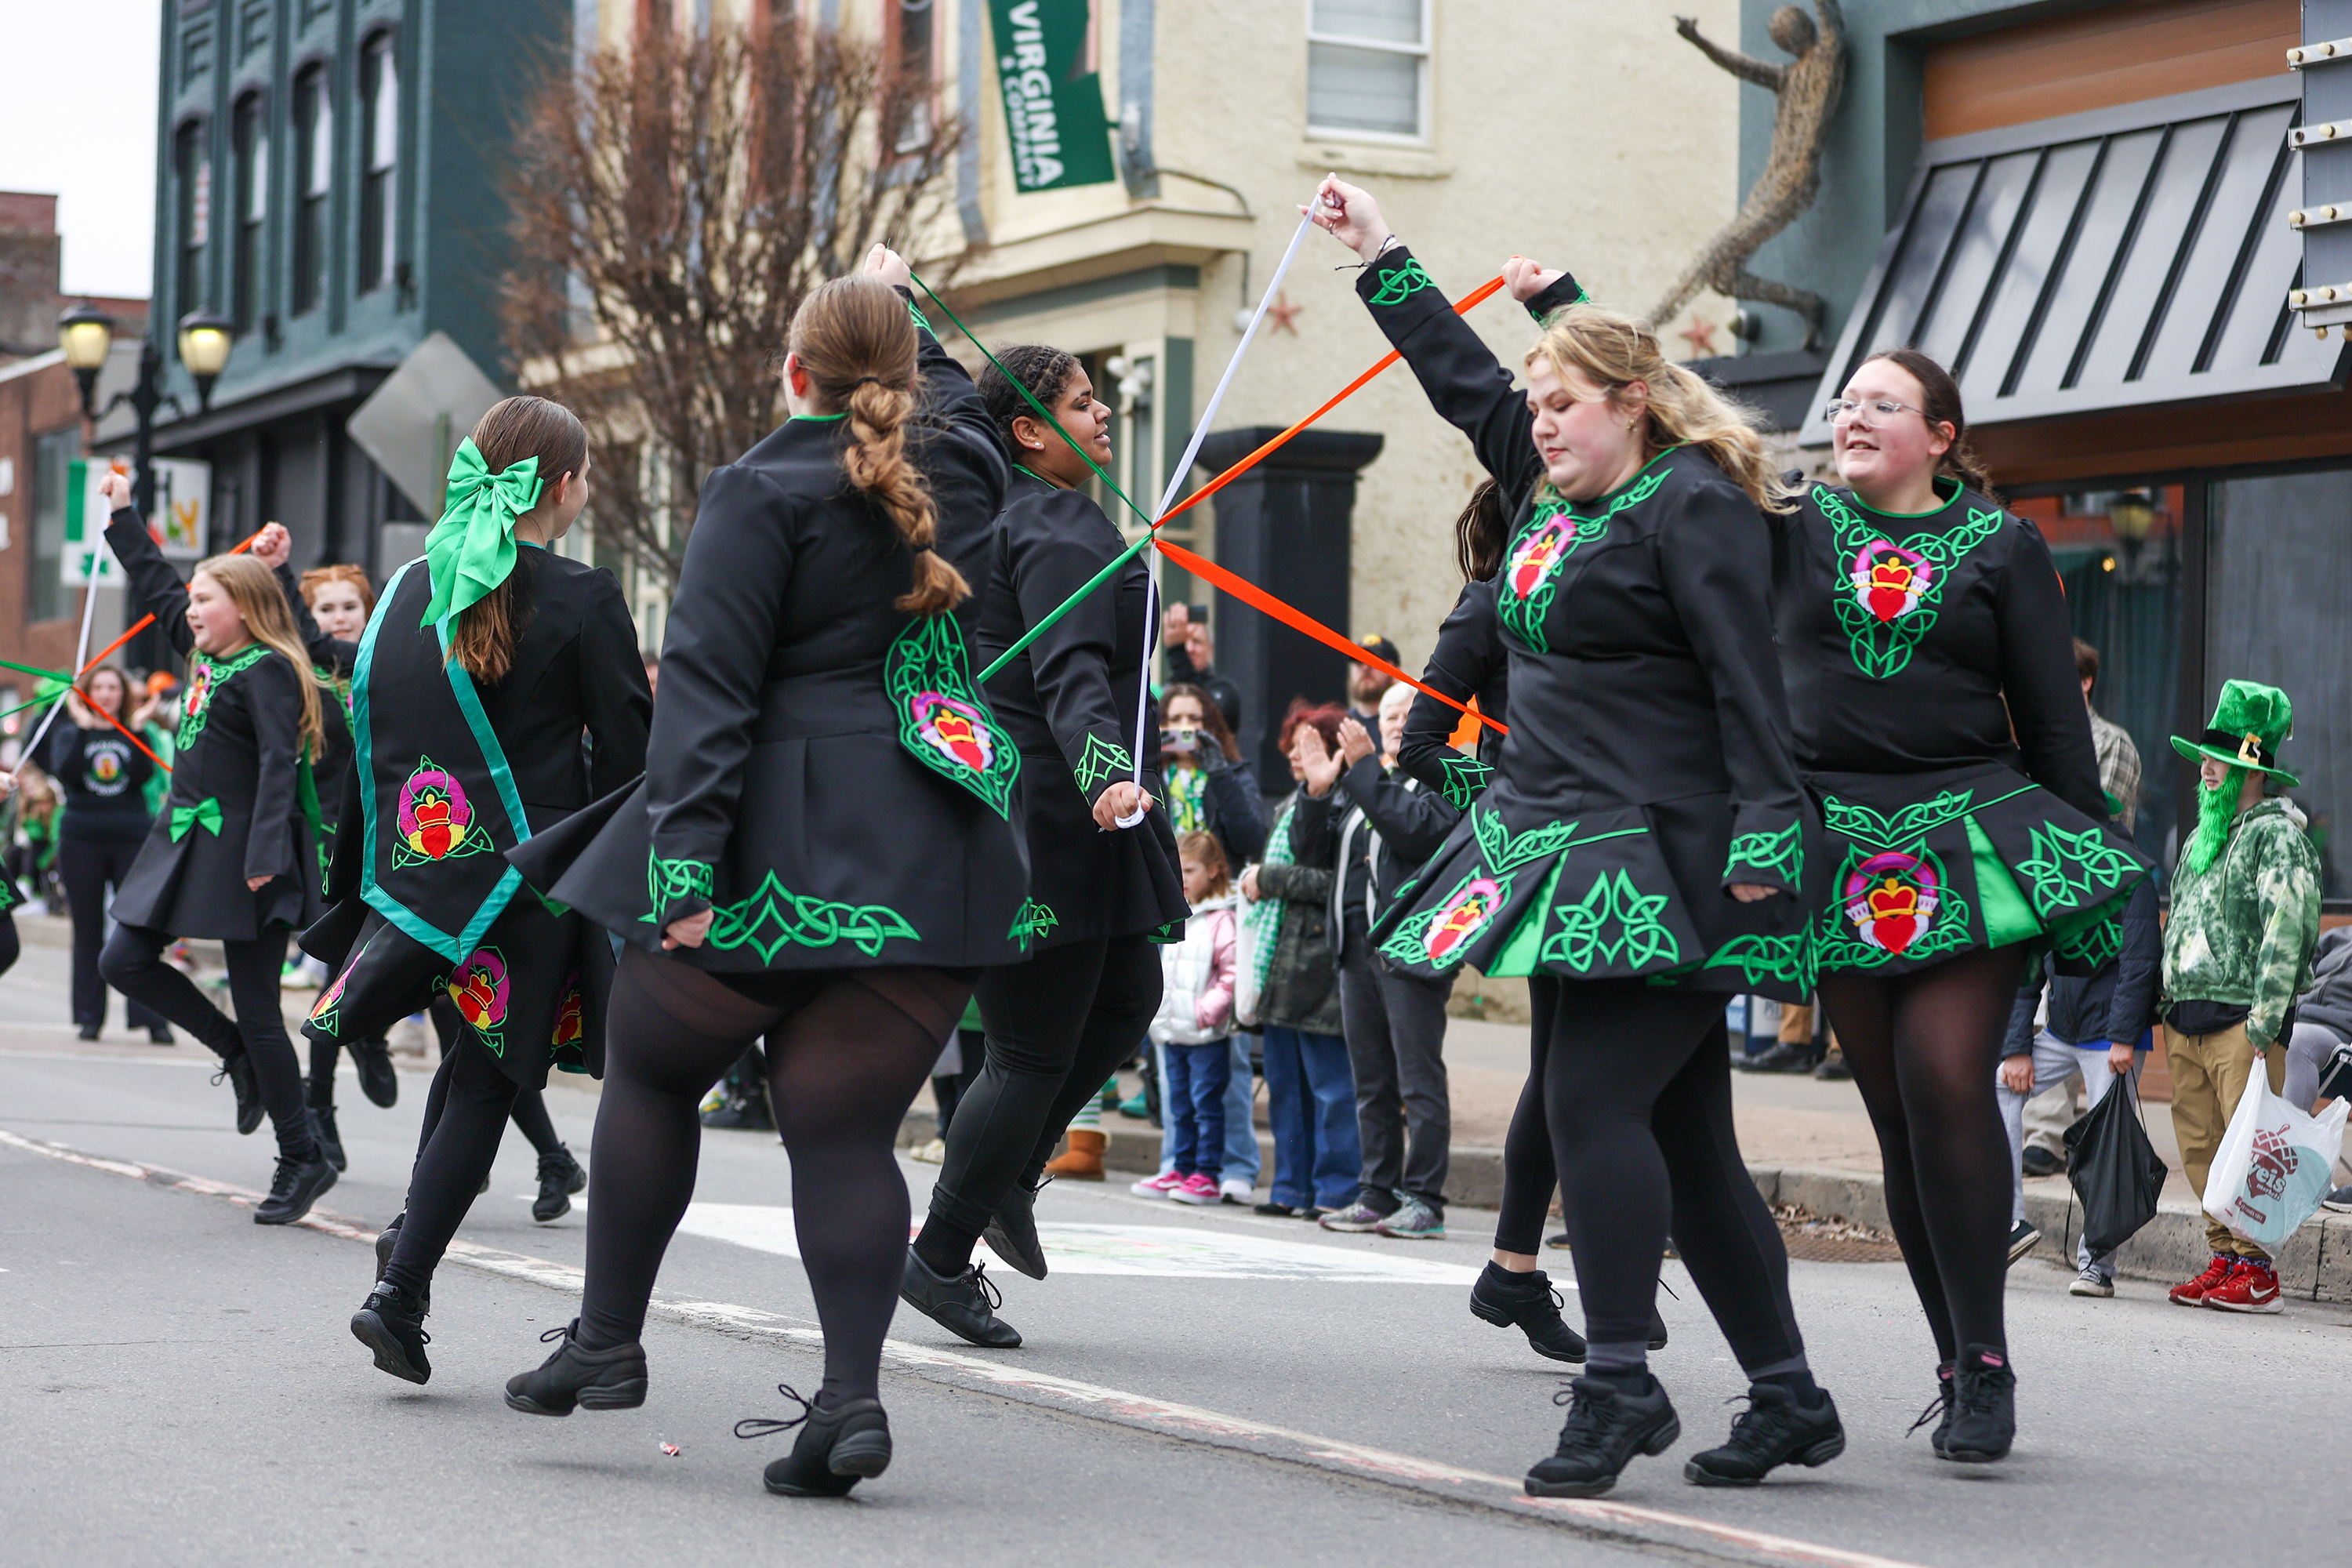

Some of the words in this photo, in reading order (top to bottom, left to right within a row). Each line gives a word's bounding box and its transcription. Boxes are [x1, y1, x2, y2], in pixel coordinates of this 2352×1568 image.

[1004, 76, 1036, 187] COMPANY
[1008, 1, 1065, 187] VIRGINIA
[2256, 1182, 2282, 1202] markets
